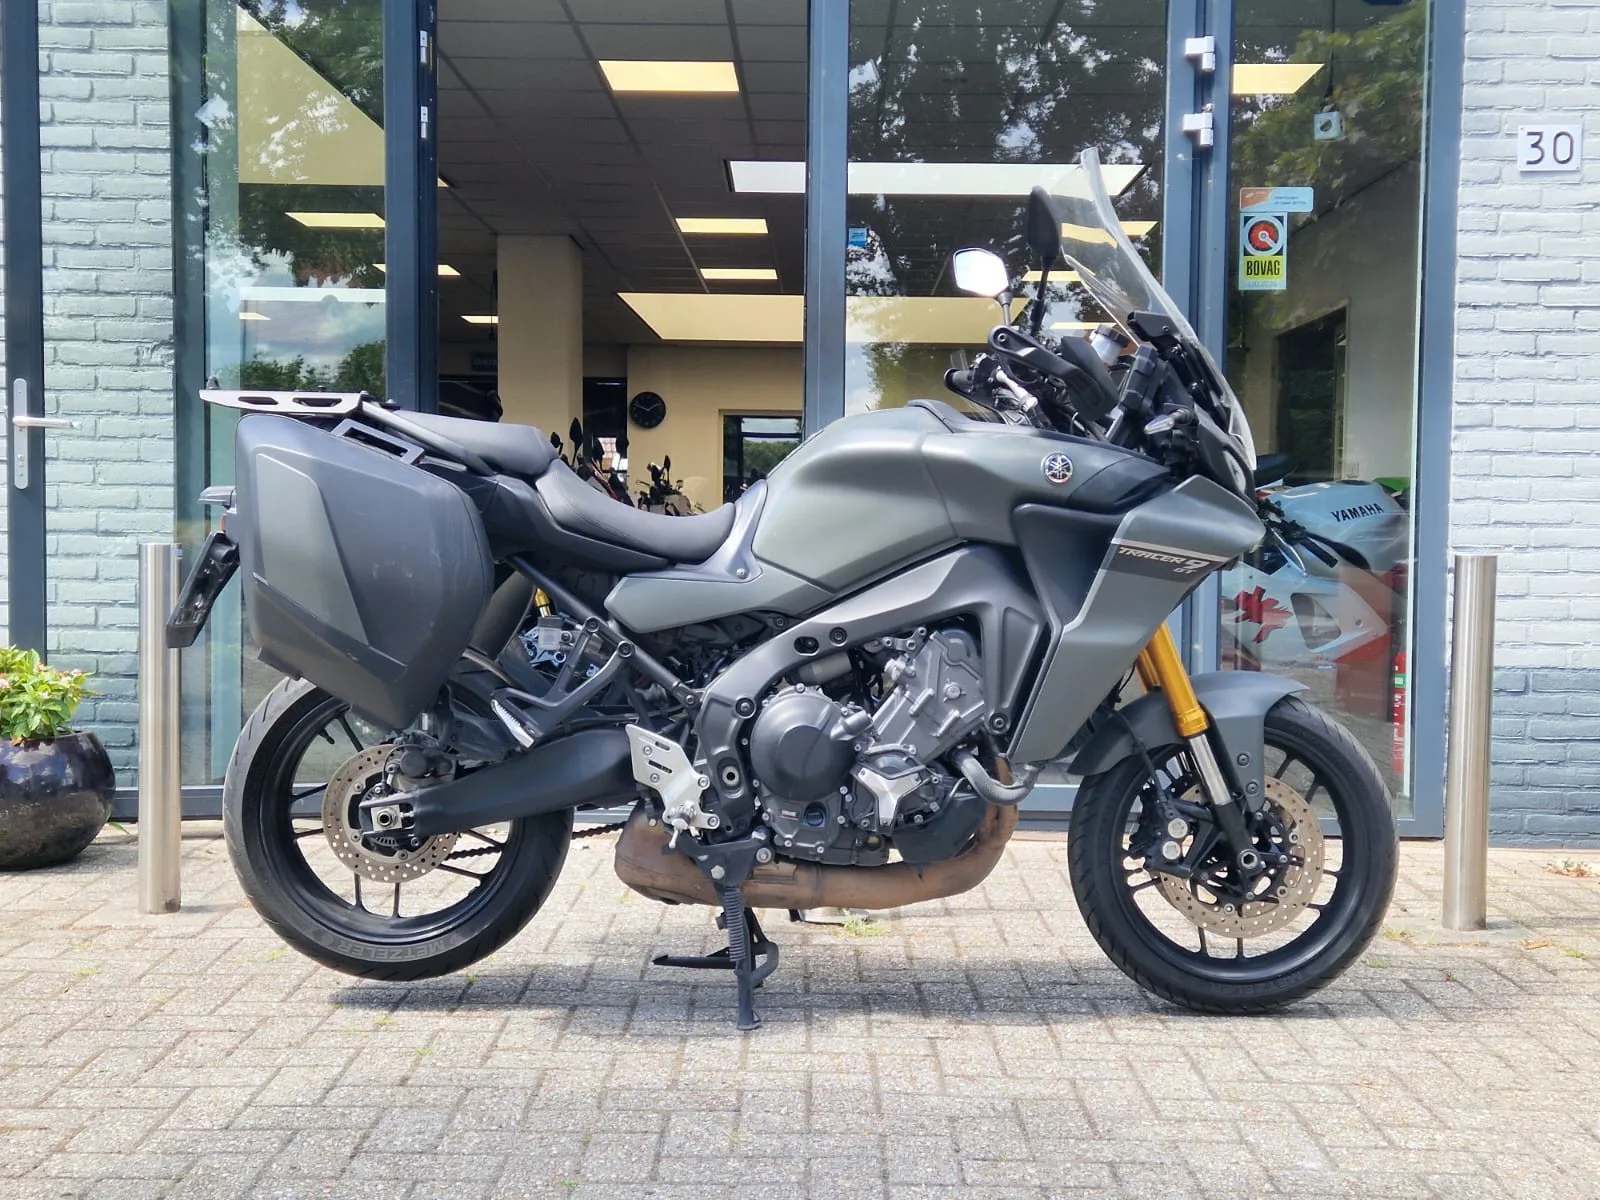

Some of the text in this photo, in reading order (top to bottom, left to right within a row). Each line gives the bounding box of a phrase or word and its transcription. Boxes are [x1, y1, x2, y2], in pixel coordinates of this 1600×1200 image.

[1526, 131, 1574, 165] 30
[1246, 260, 1281, 276] BOVAG
[1331, 503, 1384, 522] YAMAHA
[1118, 547, 1187, 565] TRACER
[1173, 567, 1197, 575] GT
[336, 939, 445, 960] METZELER
